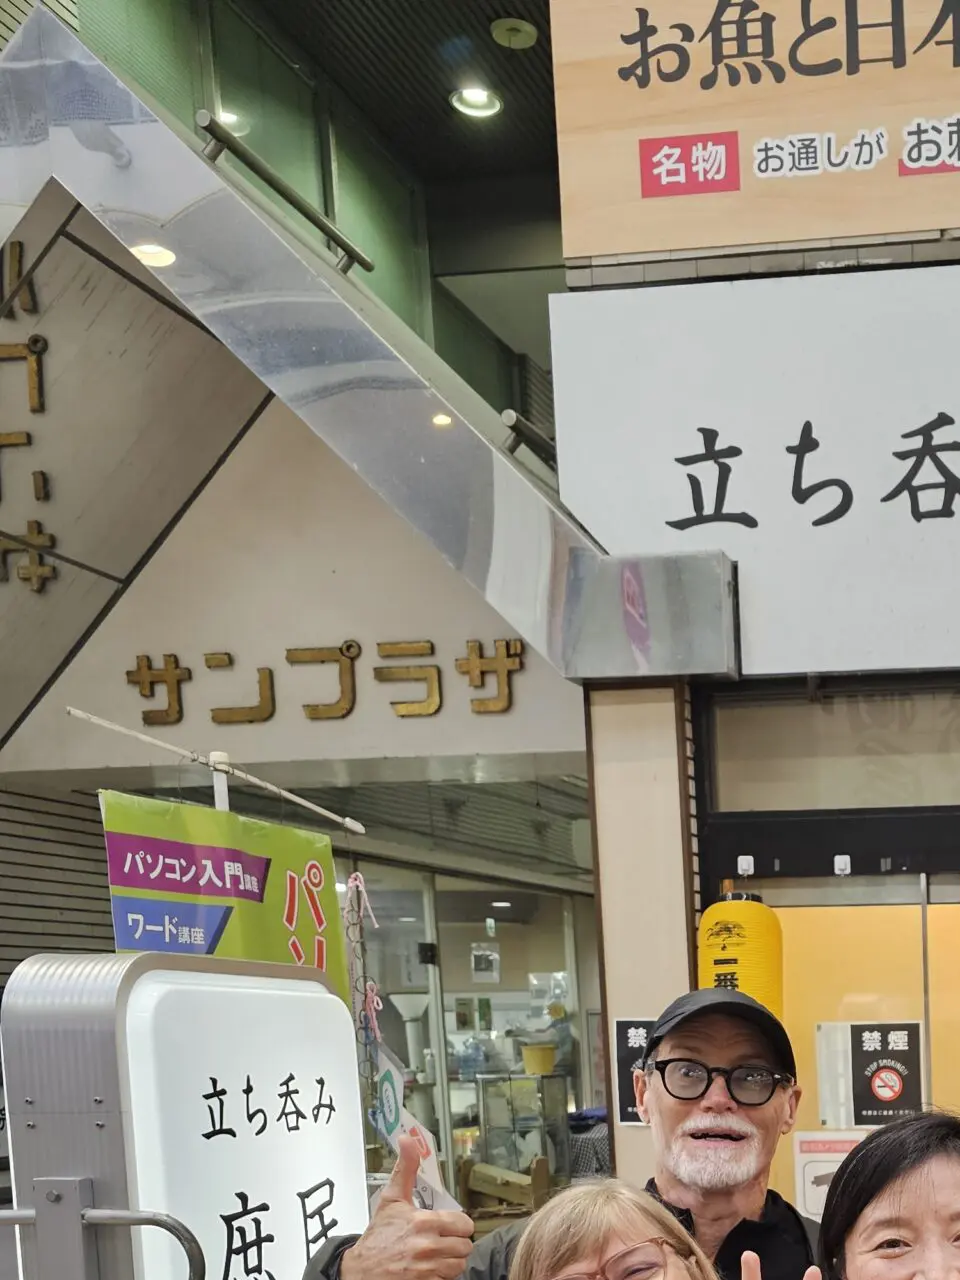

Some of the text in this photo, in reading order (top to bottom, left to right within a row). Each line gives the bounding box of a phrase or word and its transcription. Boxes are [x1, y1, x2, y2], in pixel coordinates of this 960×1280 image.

[651, 141, 727, 186] 名物
[756, 132, 885, 174] お通しが
[126, 638, 524, 726] サンプラザ
[127, 912, 206, 945] ワード講座
[862, 1031, 909, 1051] 禁煙
[201, 1072, 336, 1140] 立ち呑み
